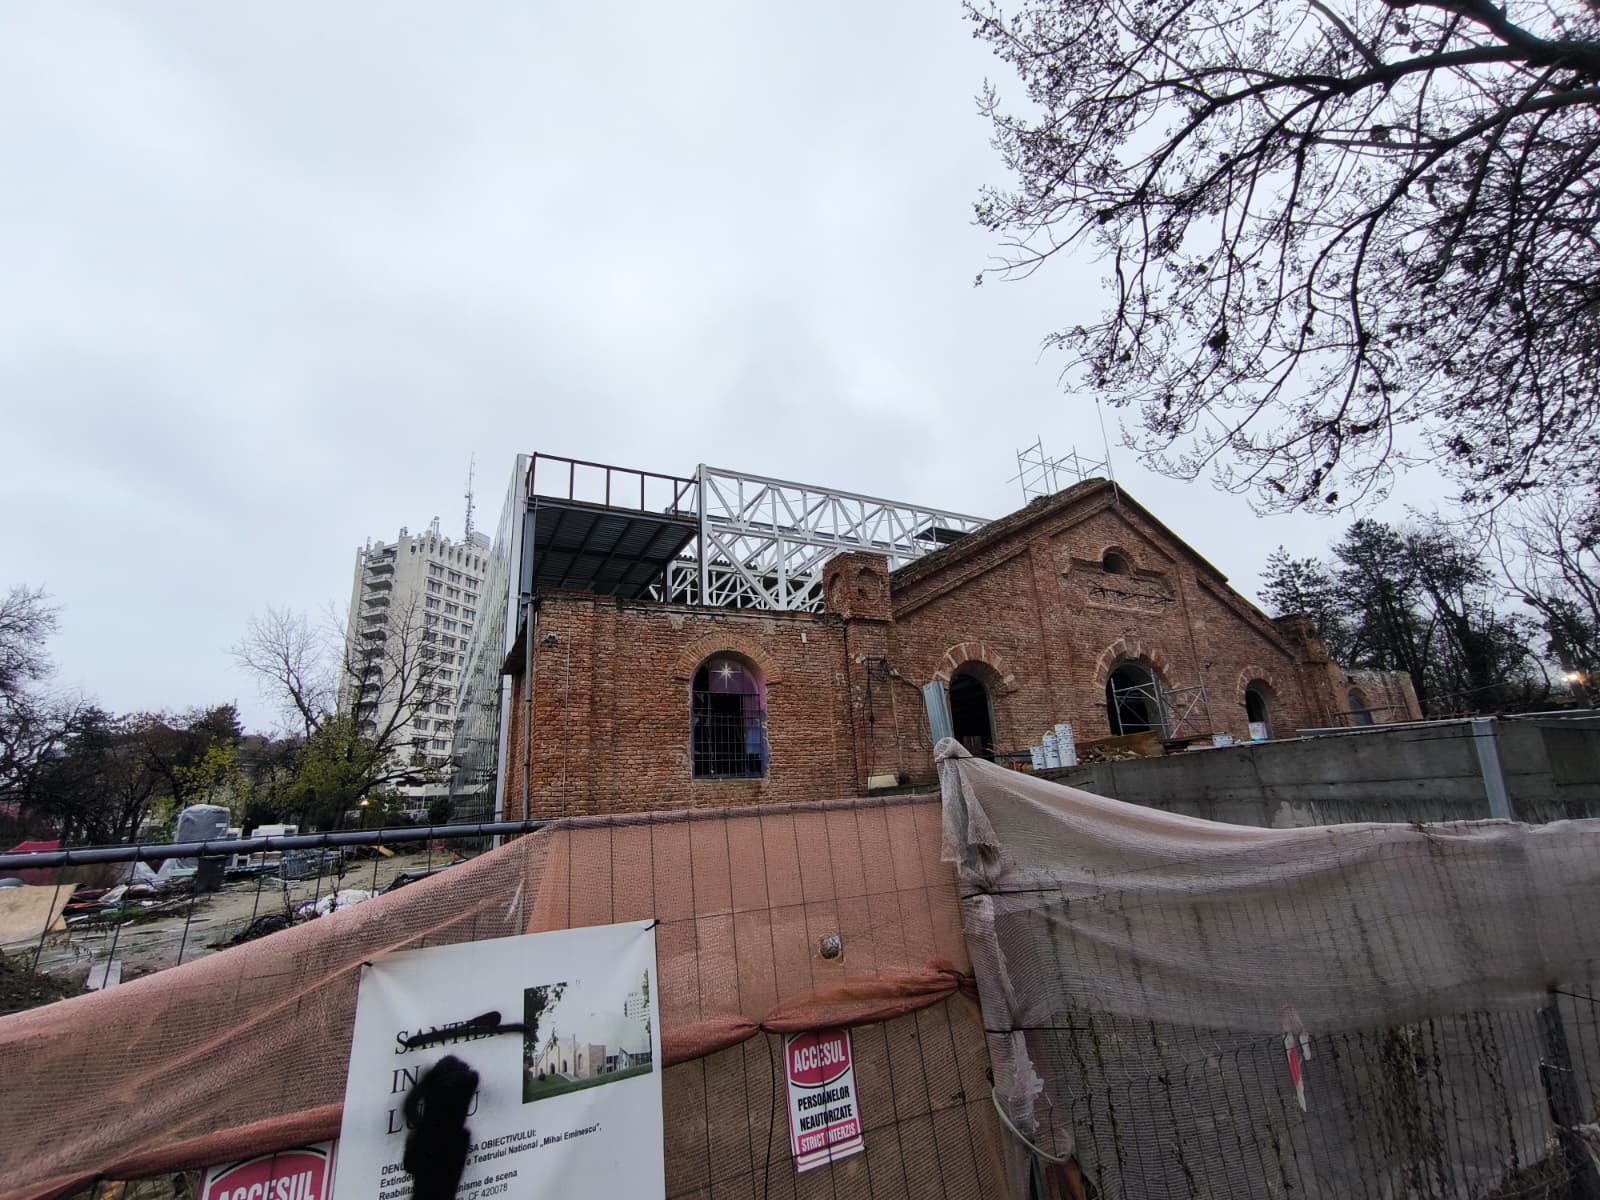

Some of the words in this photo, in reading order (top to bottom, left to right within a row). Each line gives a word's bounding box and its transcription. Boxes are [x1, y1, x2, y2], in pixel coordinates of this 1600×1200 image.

[395, 1014, 504, 1055] SANTIE
[794, 1039, 846, 1073] ACCESUL
[391, 1065, 421, 1094] IN
[797, 1085, 851, 1112] PERSOANELOR
[799, 1104, 853, 1132] NEAUTORIZATE
[481, 1128, 537, 1150] OBIECTIVULUI:
[801, 1132, 825, 1152] STRICT
[826, 1122, 856, 1144] INTERZIS
[474, 1147, 507, 1163] Teatrului
[508, 1141, 538, 1154] National
[481, 1183, 508, 1198] 420078
[484, 1176, 494, 1185] de
[495, 1169, 518, 1182] scena
